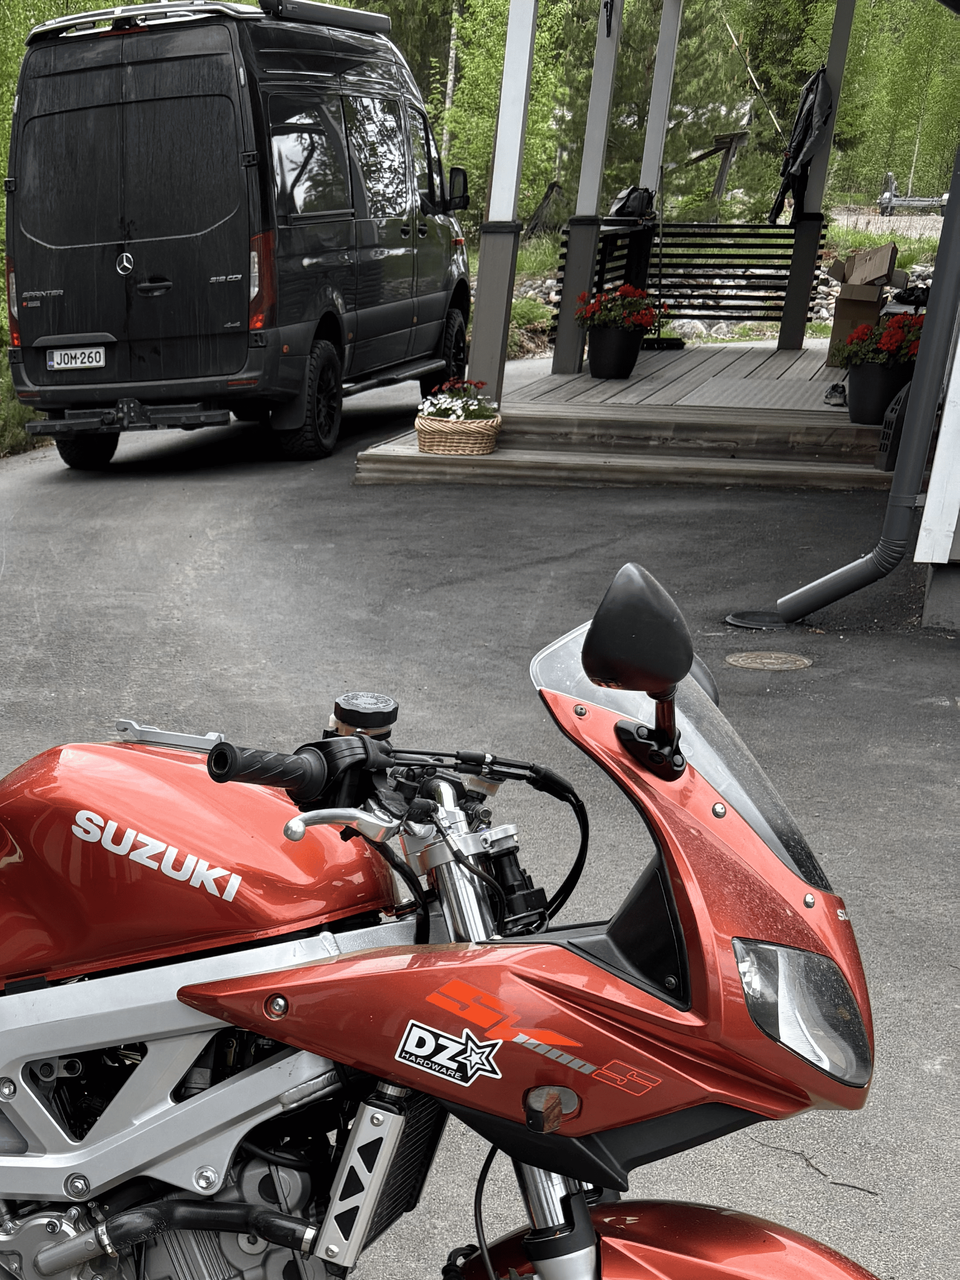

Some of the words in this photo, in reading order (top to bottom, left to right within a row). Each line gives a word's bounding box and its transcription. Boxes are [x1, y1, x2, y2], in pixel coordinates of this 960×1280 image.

[22, 289, 64, 298] SPRINTER
[56, 350, 102, 366] JOM-260
[71, 810, 242, 903] SUZUKI
[403, 1026, 466, 1070] DZ
[400, 1051, 463, 1080] HARDWARE
